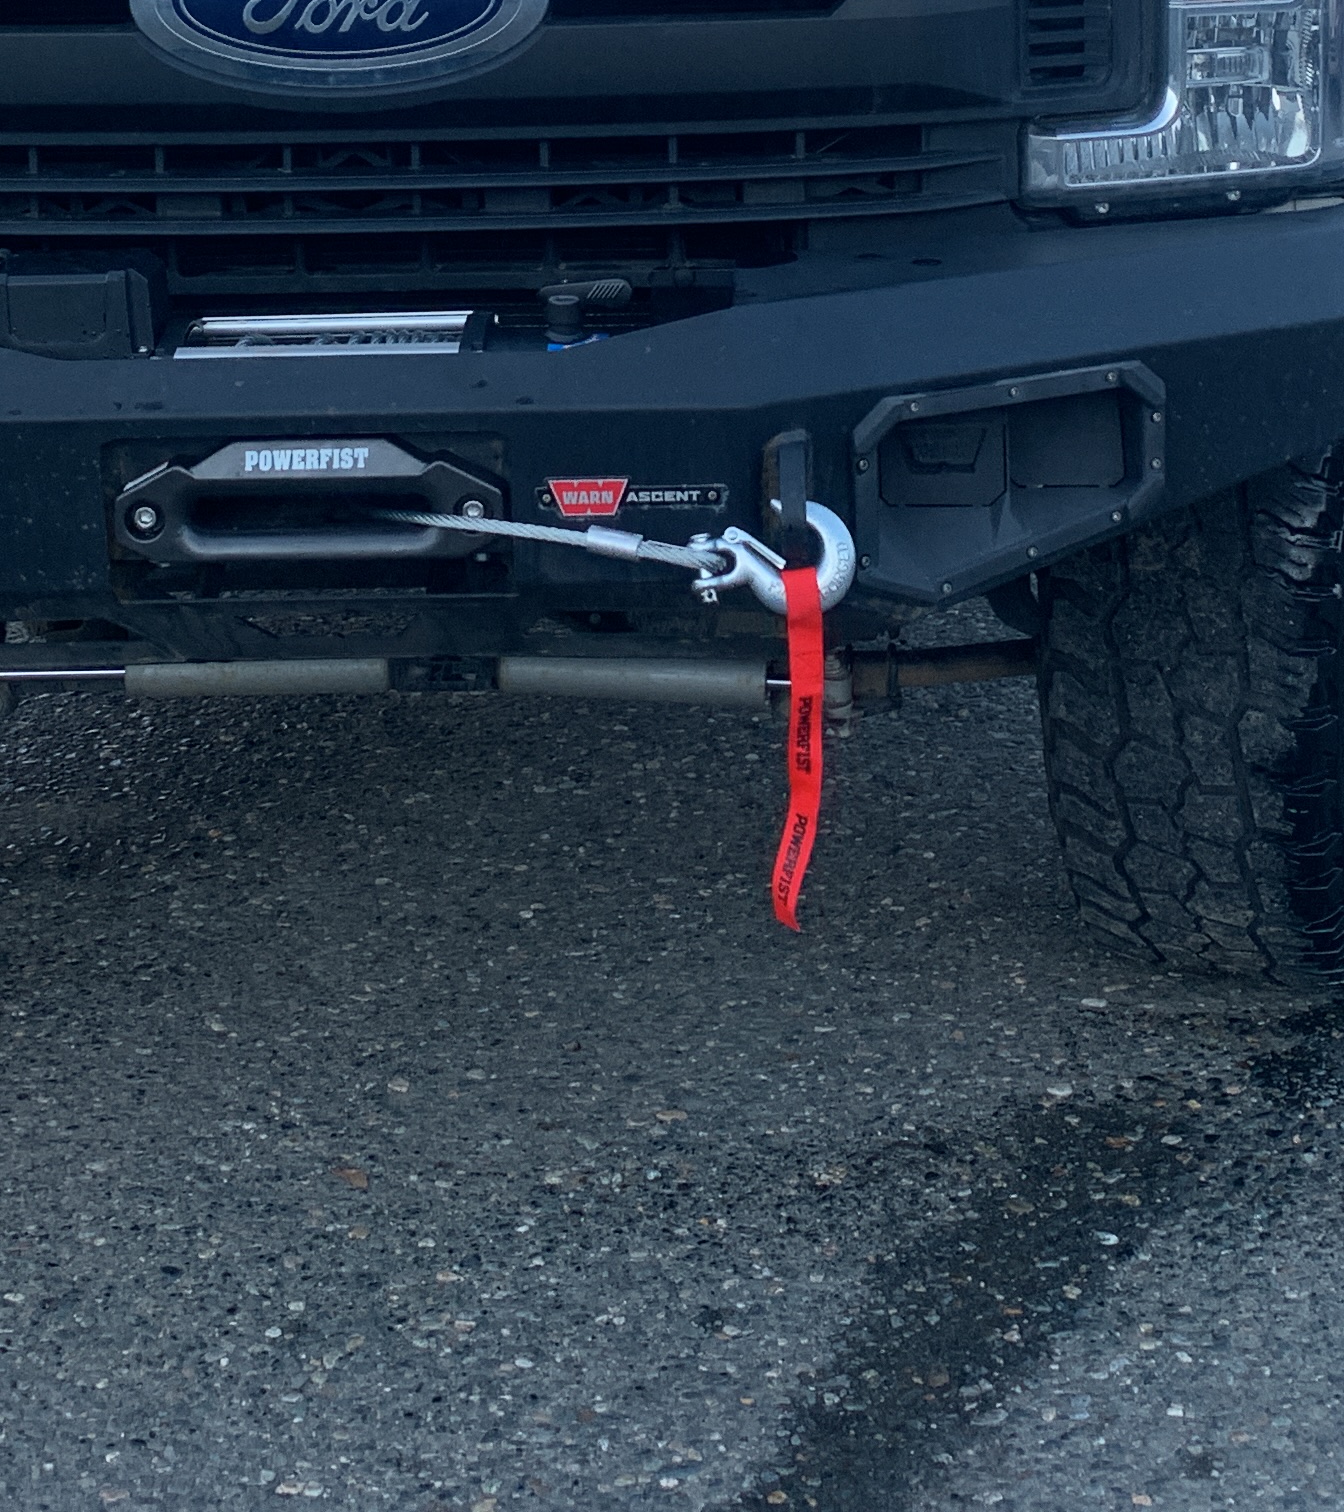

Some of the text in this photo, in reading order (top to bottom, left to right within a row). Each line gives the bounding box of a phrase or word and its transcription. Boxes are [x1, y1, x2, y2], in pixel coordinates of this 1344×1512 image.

[244, 447, 369, 472] POWERFIST
[562, 490, 702, 505] WARN ASCENT
[795, 695, 813, 775] POWERFIST
[777, 813, 809, 907] POWERFIST
